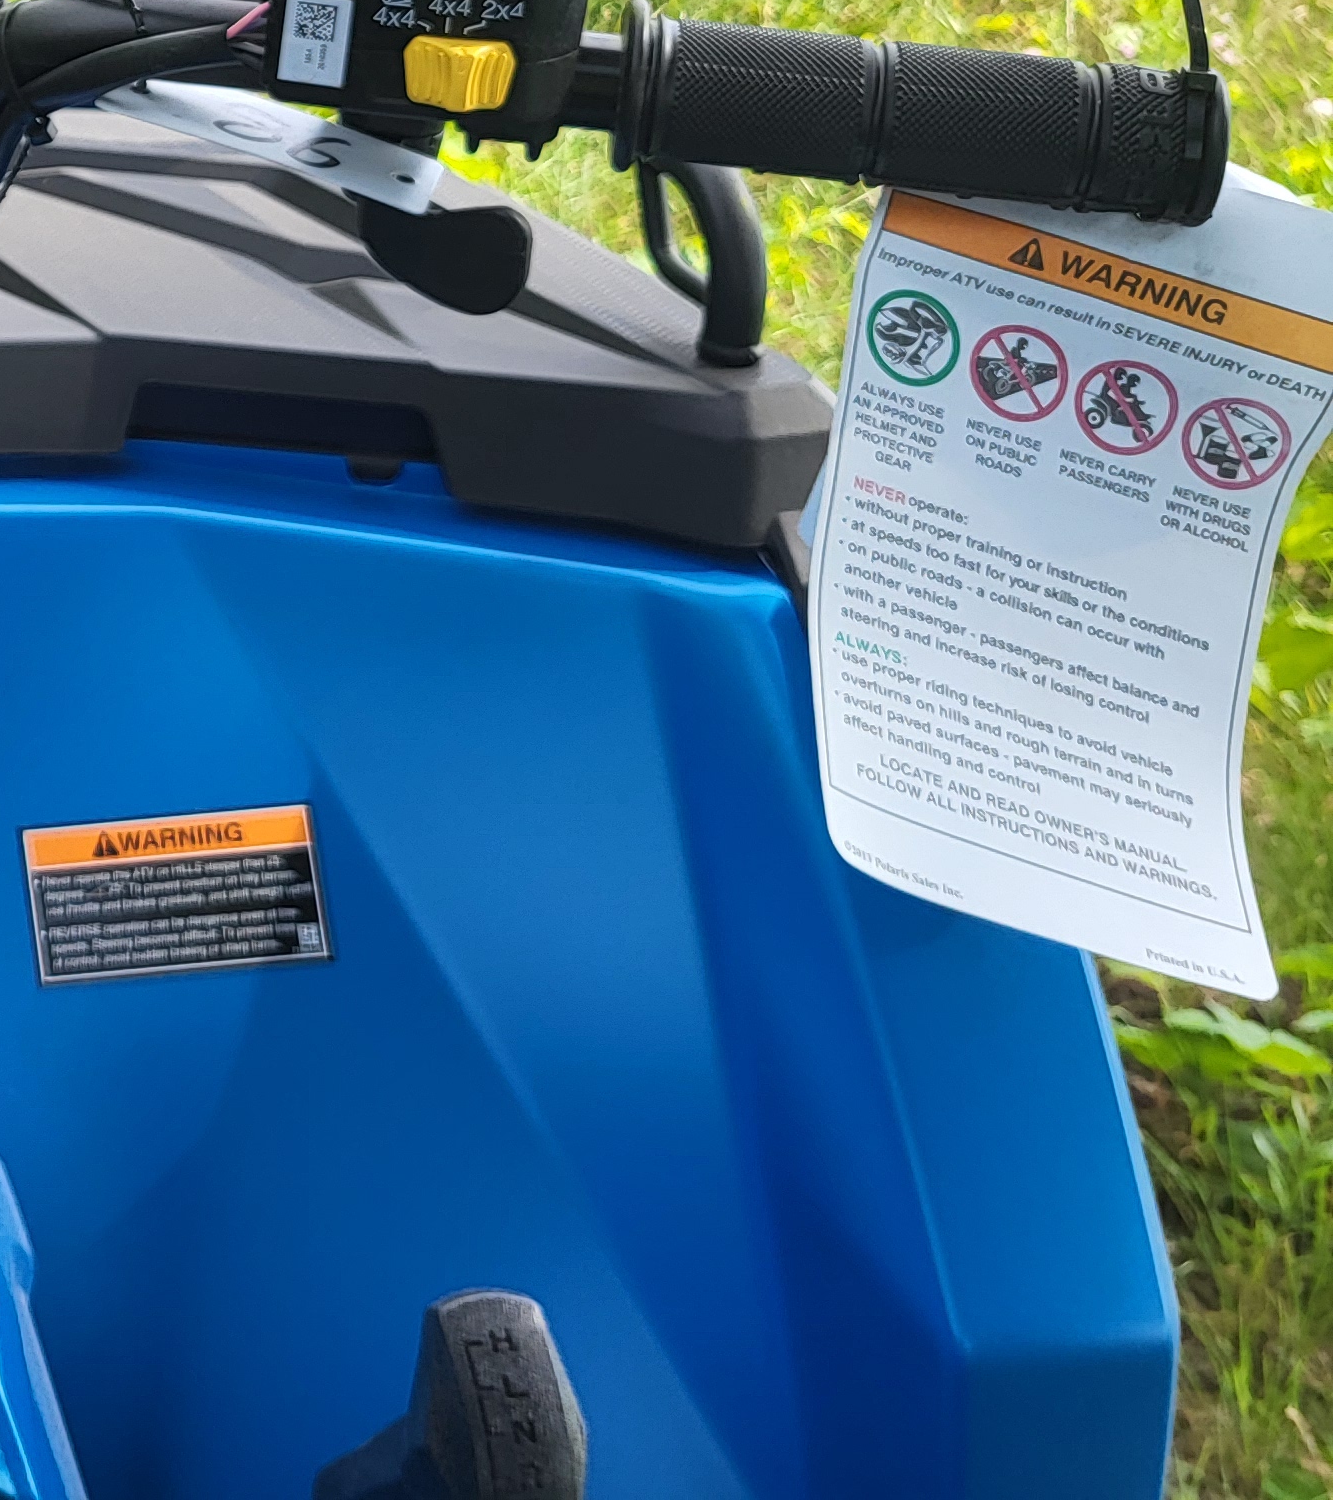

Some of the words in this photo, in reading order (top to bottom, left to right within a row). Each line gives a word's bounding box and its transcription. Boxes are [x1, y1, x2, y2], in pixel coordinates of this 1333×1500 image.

[1061, 250, 1227, 325] WARNING
[878, 248, 950, 287] Improper
[949, 272, 986, 290] ATV
[986, 284, 1015, 300] use
[1017, 294, 1046, 310] can
[1047, 304, 1095, 326] result
[1095, 316, 1111, 330] in
[1112, 323, 1182, 354] SEVERE
[1182, 346, 1248, 374] INJURY
[1247, 370, 1266, 381] or
[1265, 368, 1327, 402] DEATH
[853, 395, 871, 410] AN
[873, 402, 945, 434] APPROVED
[861, 382, 915, 408] ALWAYS
[918, 401, 945, 419] USE
[854, 428, 933, 464] PROTECTIVE
[855, 412, 907, 438] HELMET
[909, 431, 937, 448] AND
[966, 418, 1012, 442] NEVER
[1015, 434, 1042, 452] USE
[875, 450, 912, 472] GEAR
[965, 434, 985, 450] ON
[989, 442, 1037, 466] PUBLIC
[975, 454, 1022, 478] ROADS
[1059, 448, 1105, 472] NEVER
[1108, 465, 1157, 488] CARRY
[854, 475, 905, 505] NEVER
[1059, 465, 1149, 503] PASSENGERS
[1166, 500, 1199, 520] WITH
[1202, 512, 1251, 536] DRUGS
[1172, 485, 1219, 510] NEVER
[1223, 501, 1251, 520] USE
[1160, 515, 1181, 530] OR
[1182, 523, 1247, 552] ALCOHOL
[836, 631, 907, 666] ALWAYS:
[880, 754, 943, 789] LOCATE
[947, 780, 981, 800] AND
[986, 793, 1030, 818] READ
[1034, 810, 1110, 846] OWNER'S
[119, 821, 243, 852] WARNING
[857, 763, 922, 799] FOLLOW
[926, 791, 953, 811] ALL
[961, 802, 1080, 854] INSTRUCTIONS
[1084, 846, 1119, 866] AND
[1123, 858, 1217, 901] WARNINGS.
[489, 1328, 518, 1353] H
[502, 1374, 530, 1398] L
